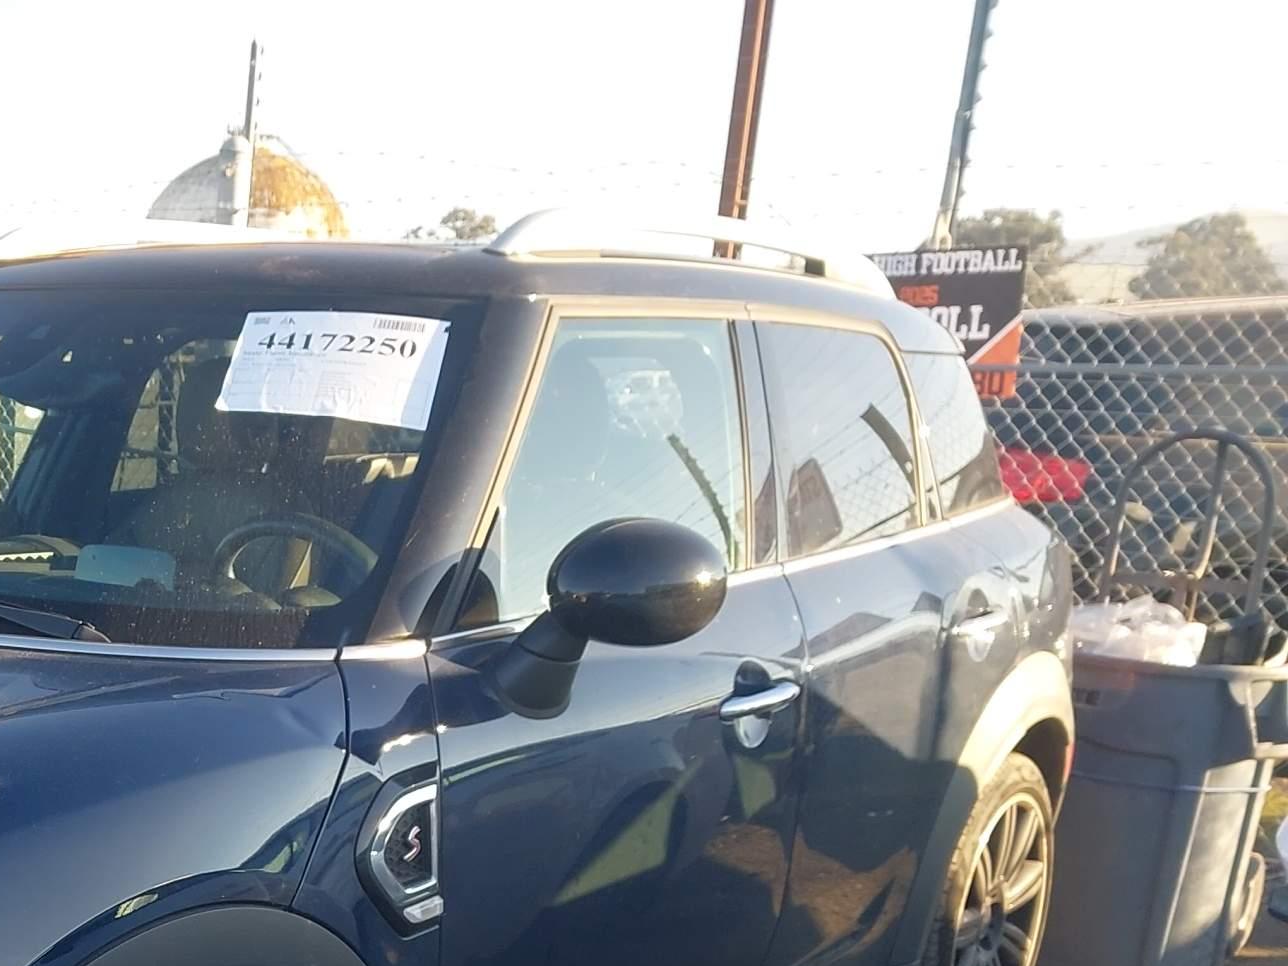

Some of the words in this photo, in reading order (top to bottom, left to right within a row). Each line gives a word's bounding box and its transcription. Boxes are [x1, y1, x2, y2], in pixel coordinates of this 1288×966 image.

[873, 254, 918, 277] HIGH
[920, 249, 1023, 275] FOOTBALL
[257, 331, 417, 359] 44172250
[402, 825, 422, 863] S
